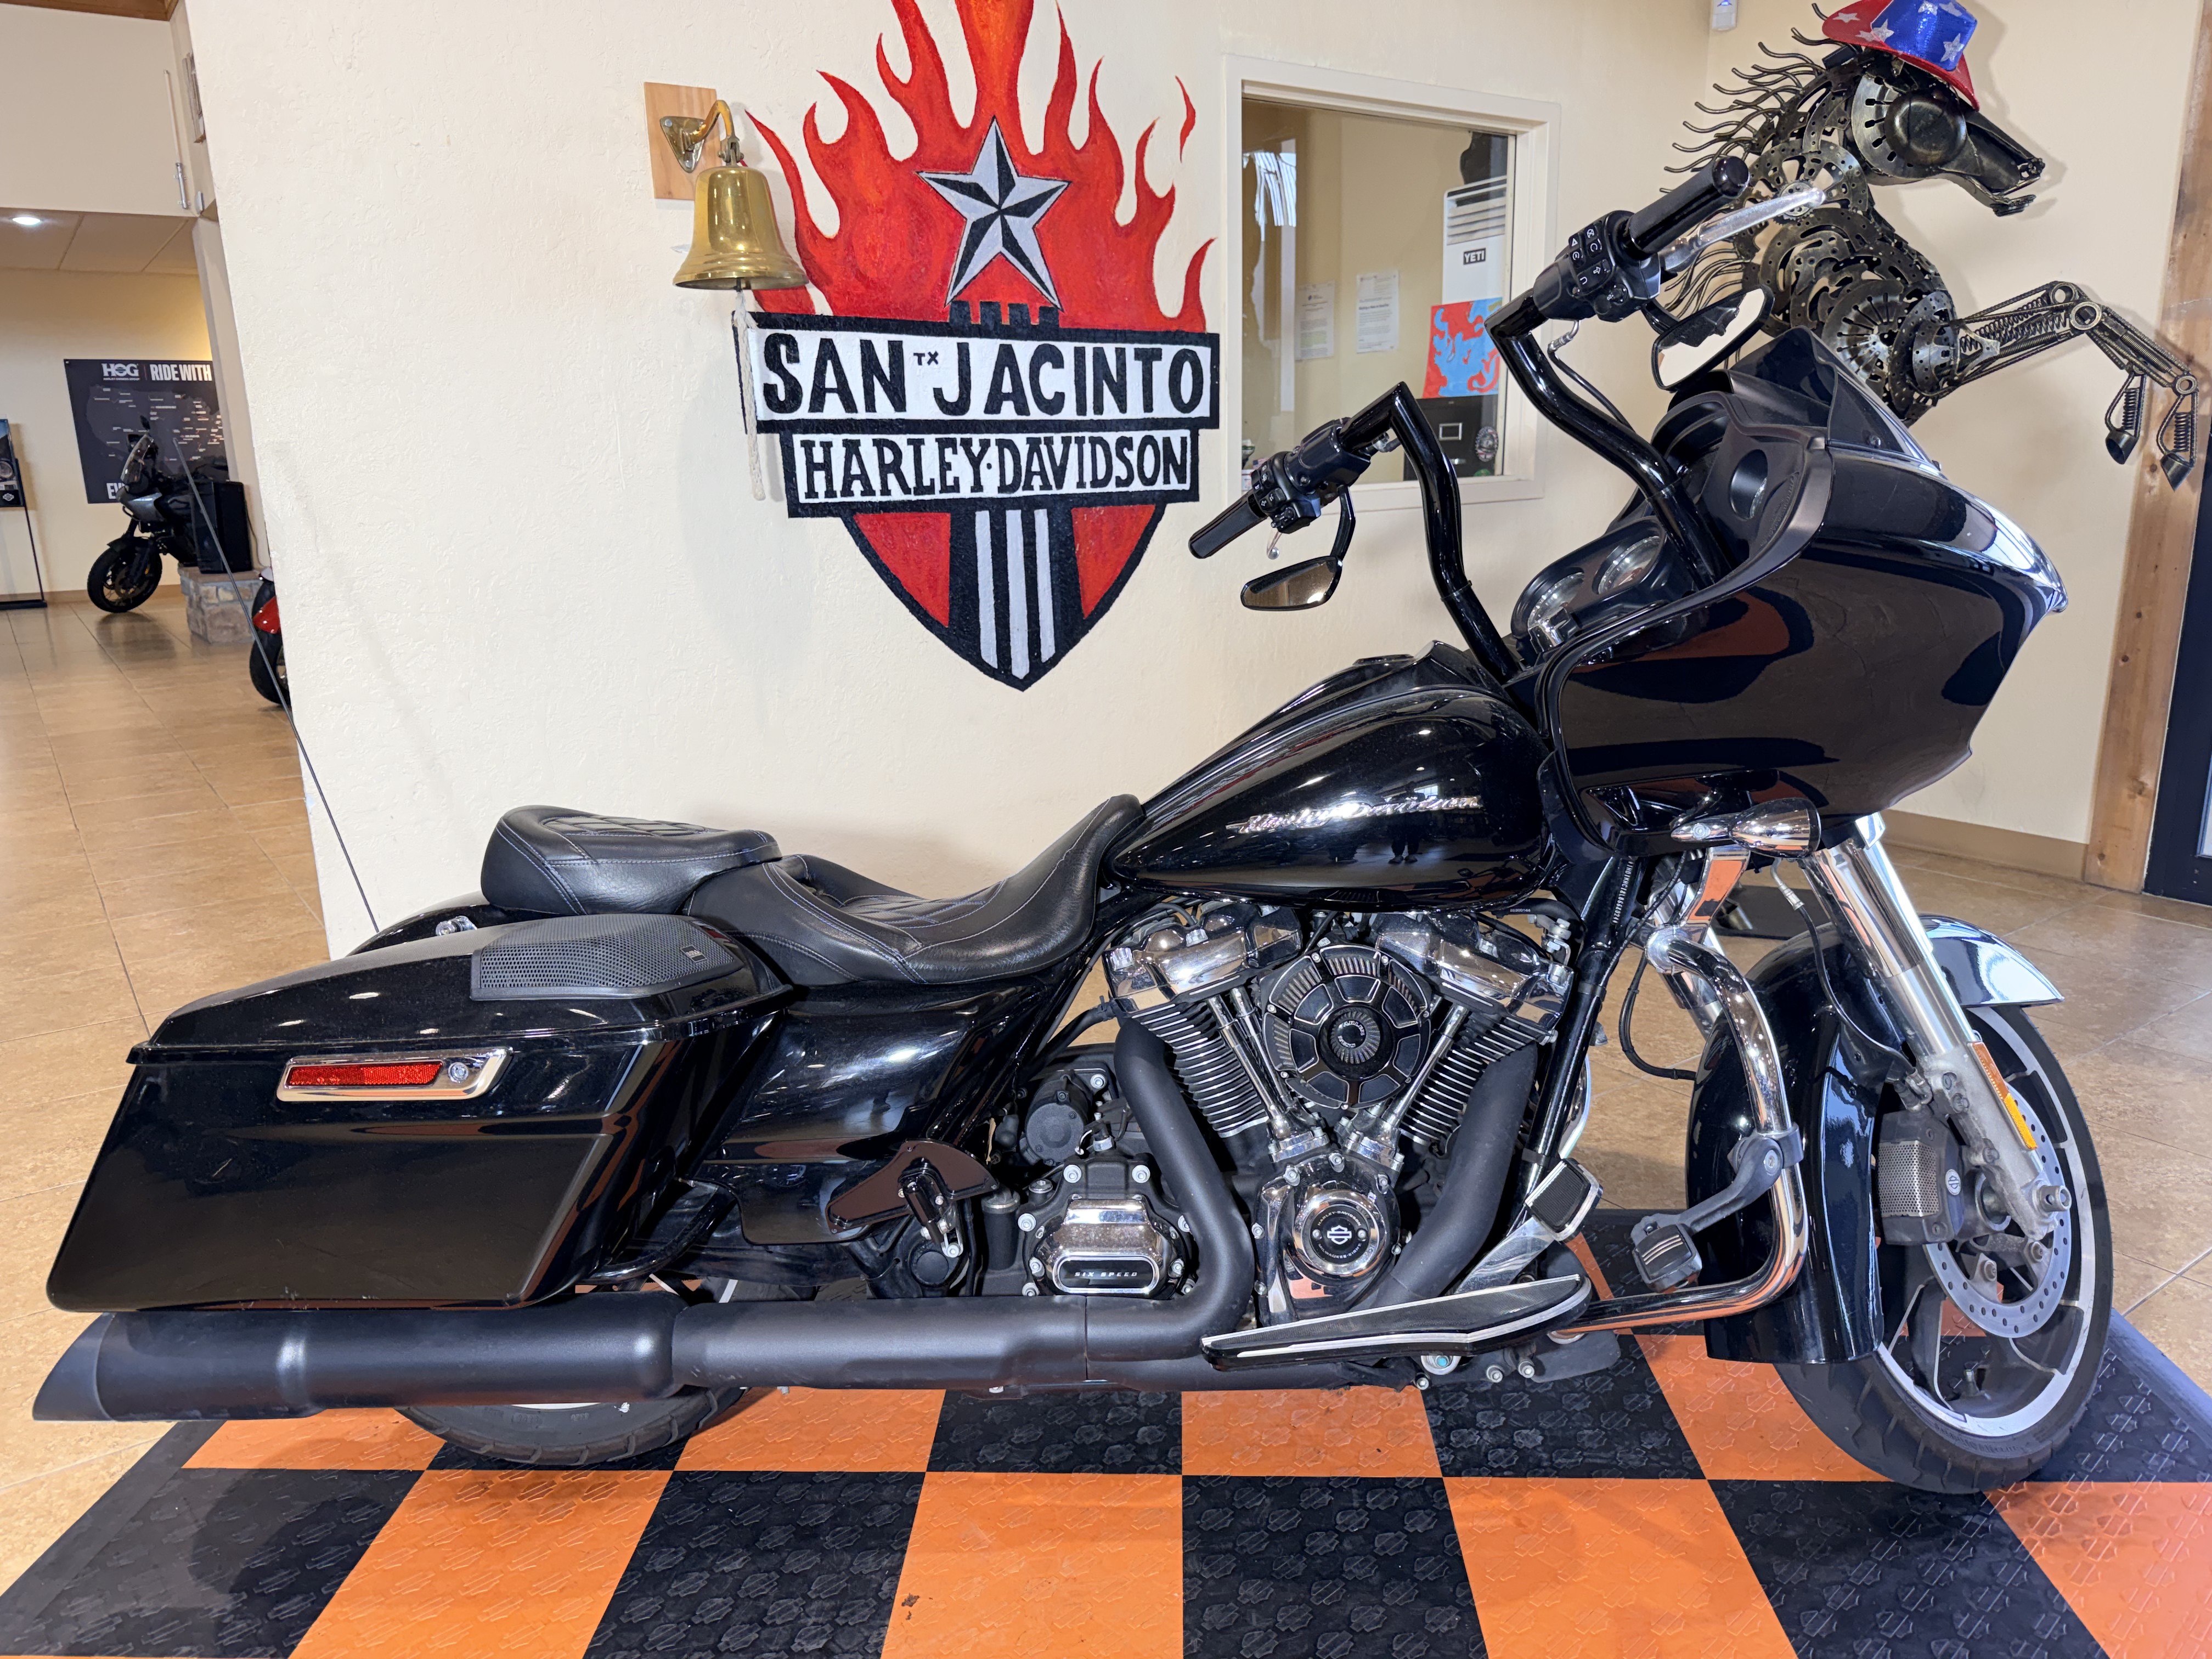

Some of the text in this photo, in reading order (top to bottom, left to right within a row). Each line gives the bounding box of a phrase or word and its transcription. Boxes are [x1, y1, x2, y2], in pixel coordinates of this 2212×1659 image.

[1464, 250, 1485, 263] YETI
[913, 351, 939, 366] TX
[101, 363, 213, 381] HOG RIDE WITH
[763, 333, 1204, 416] SAN JACINTO
